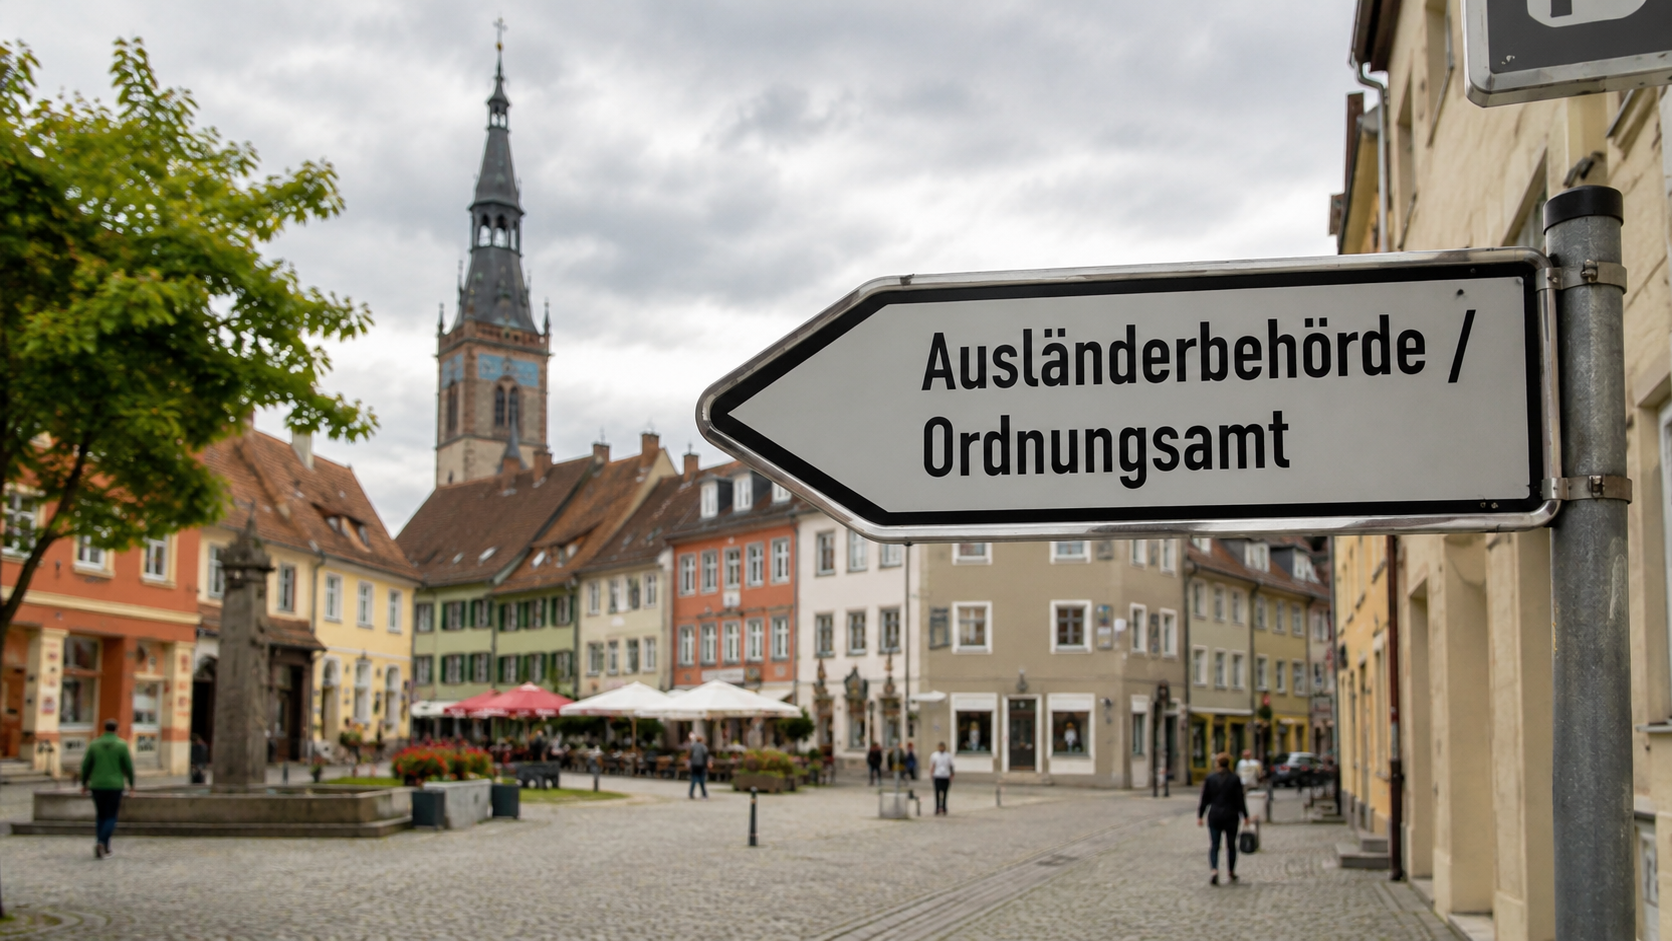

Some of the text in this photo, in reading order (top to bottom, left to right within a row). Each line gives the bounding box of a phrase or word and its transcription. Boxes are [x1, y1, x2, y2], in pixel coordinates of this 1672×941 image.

[921, 309, 1477, 391] Ausländerbehörde /
[923, 410, 1290, 490] Ordnungsamt
